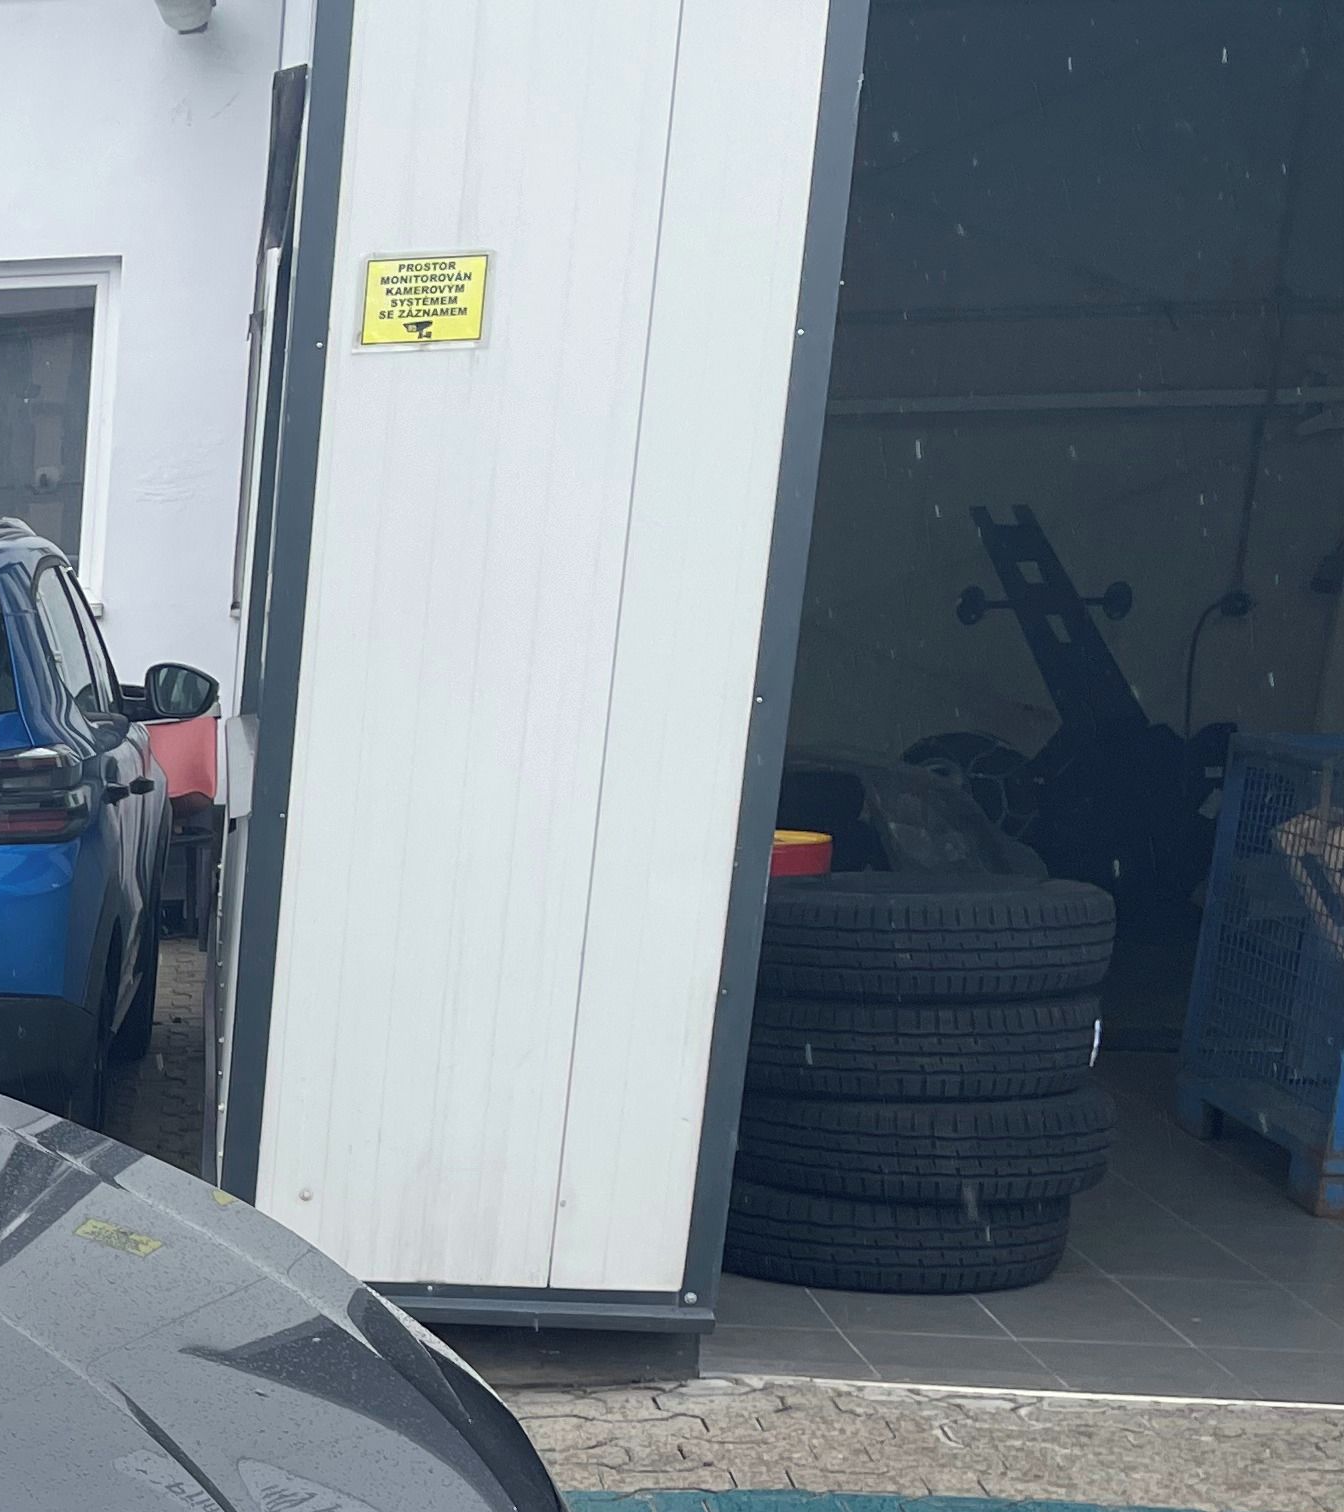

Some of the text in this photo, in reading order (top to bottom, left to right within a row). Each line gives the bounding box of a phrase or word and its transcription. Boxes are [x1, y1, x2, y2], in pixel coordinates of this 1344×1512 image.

[398, 261, 456, 273] PROSTOR
[380, 270, 472, 285] MONITOROVÁN
[379, 306, 468, 319] SE ZÁZNAMEM
